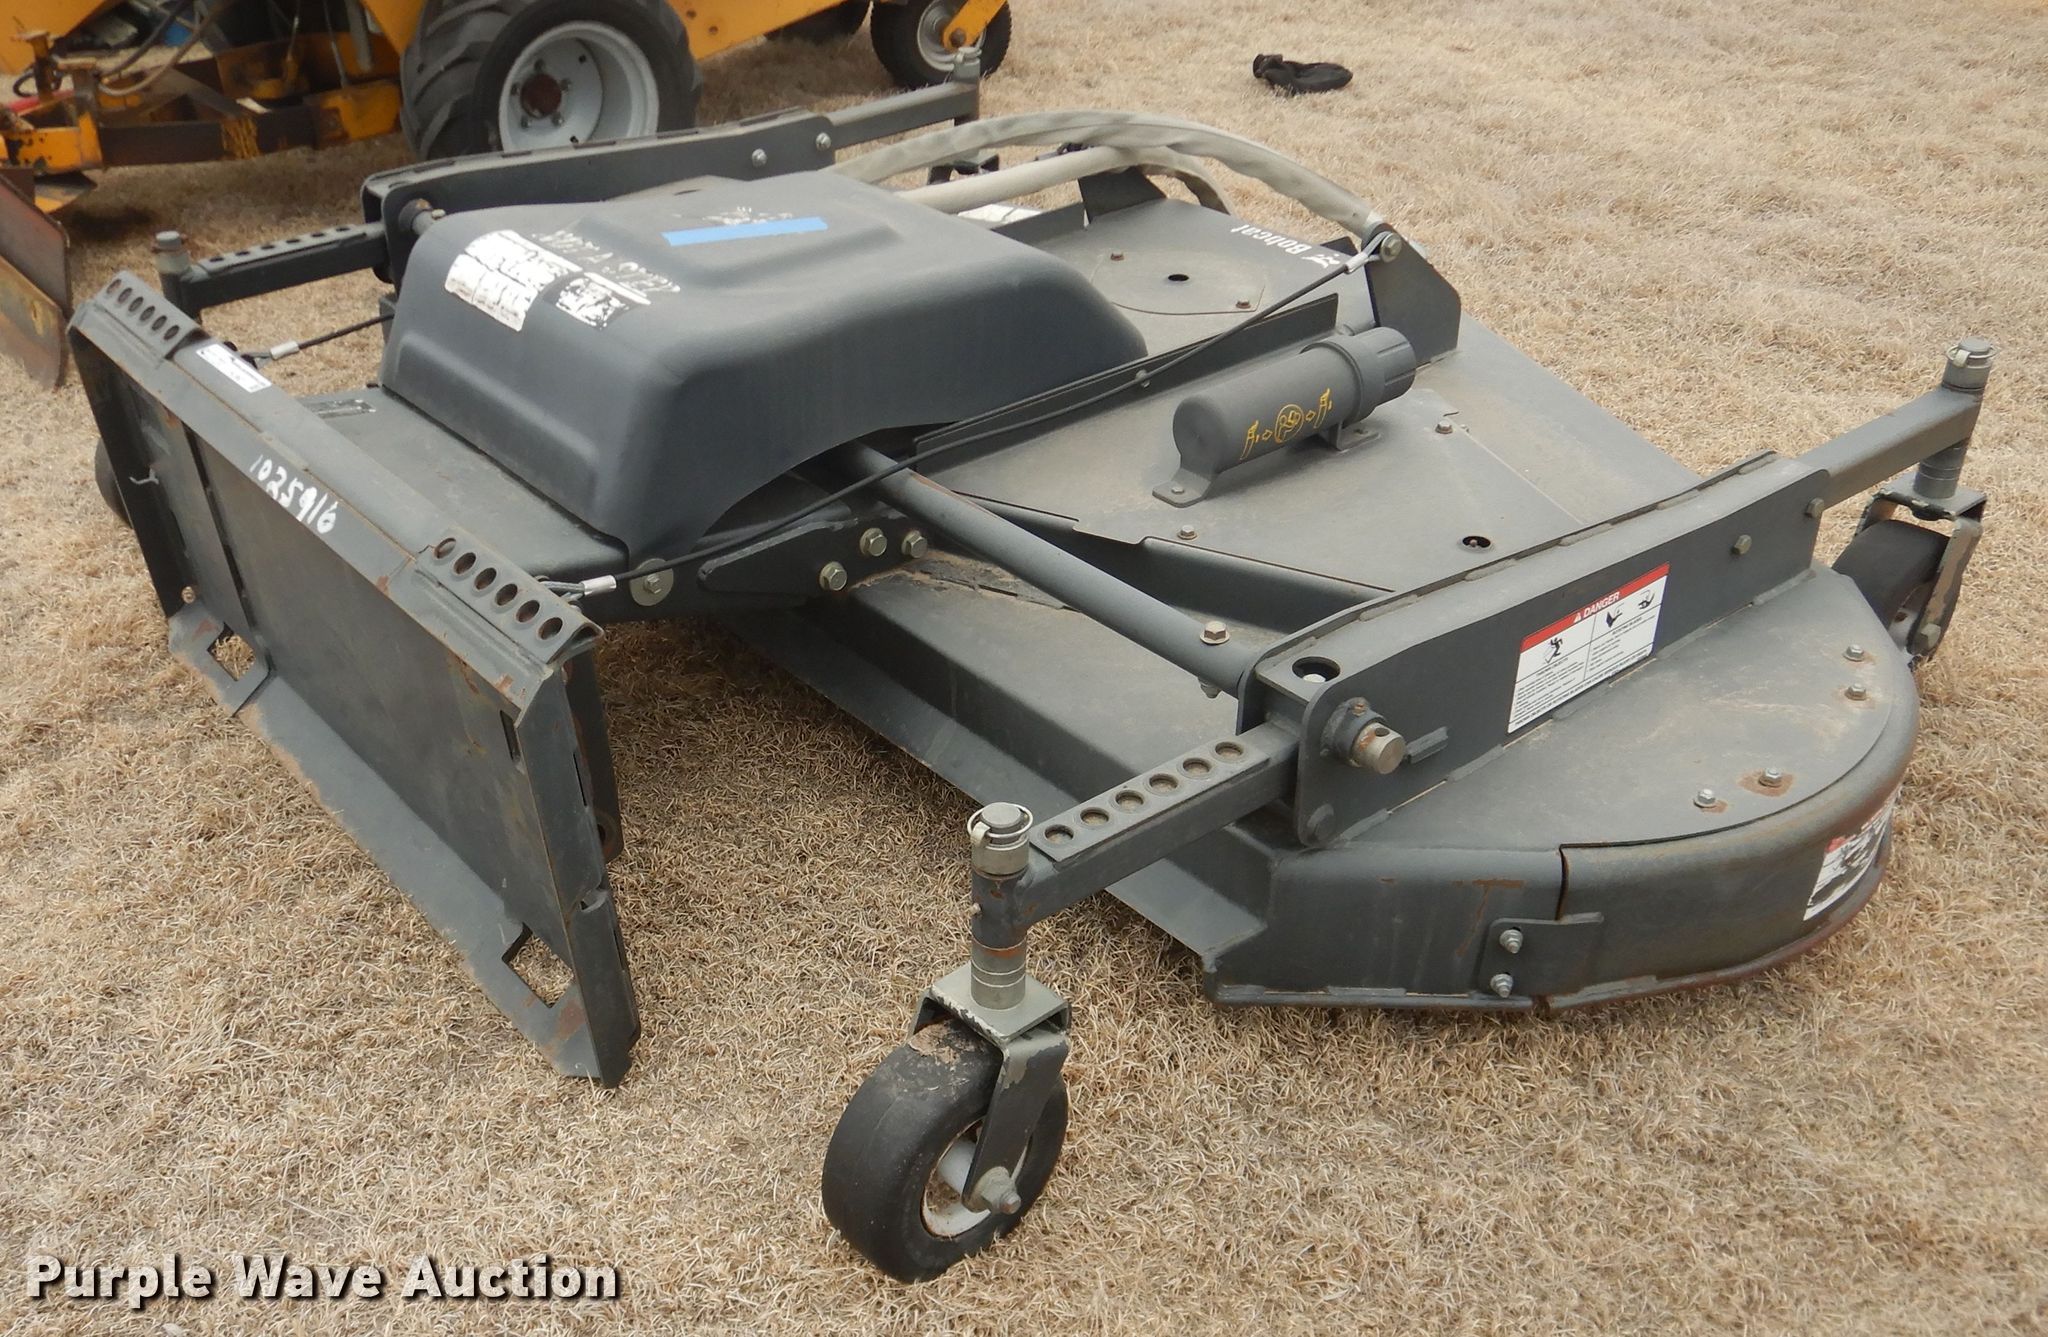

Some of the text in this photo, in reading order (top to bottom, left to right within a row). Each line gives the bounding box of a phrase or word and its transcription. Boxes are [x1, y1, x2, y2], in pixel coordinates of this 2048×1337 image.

[1230, 224, 1312, 255] Bobcat
[250, 455, 338, 534] 1025916
[1583, 591, 1621, 618] DANGER
